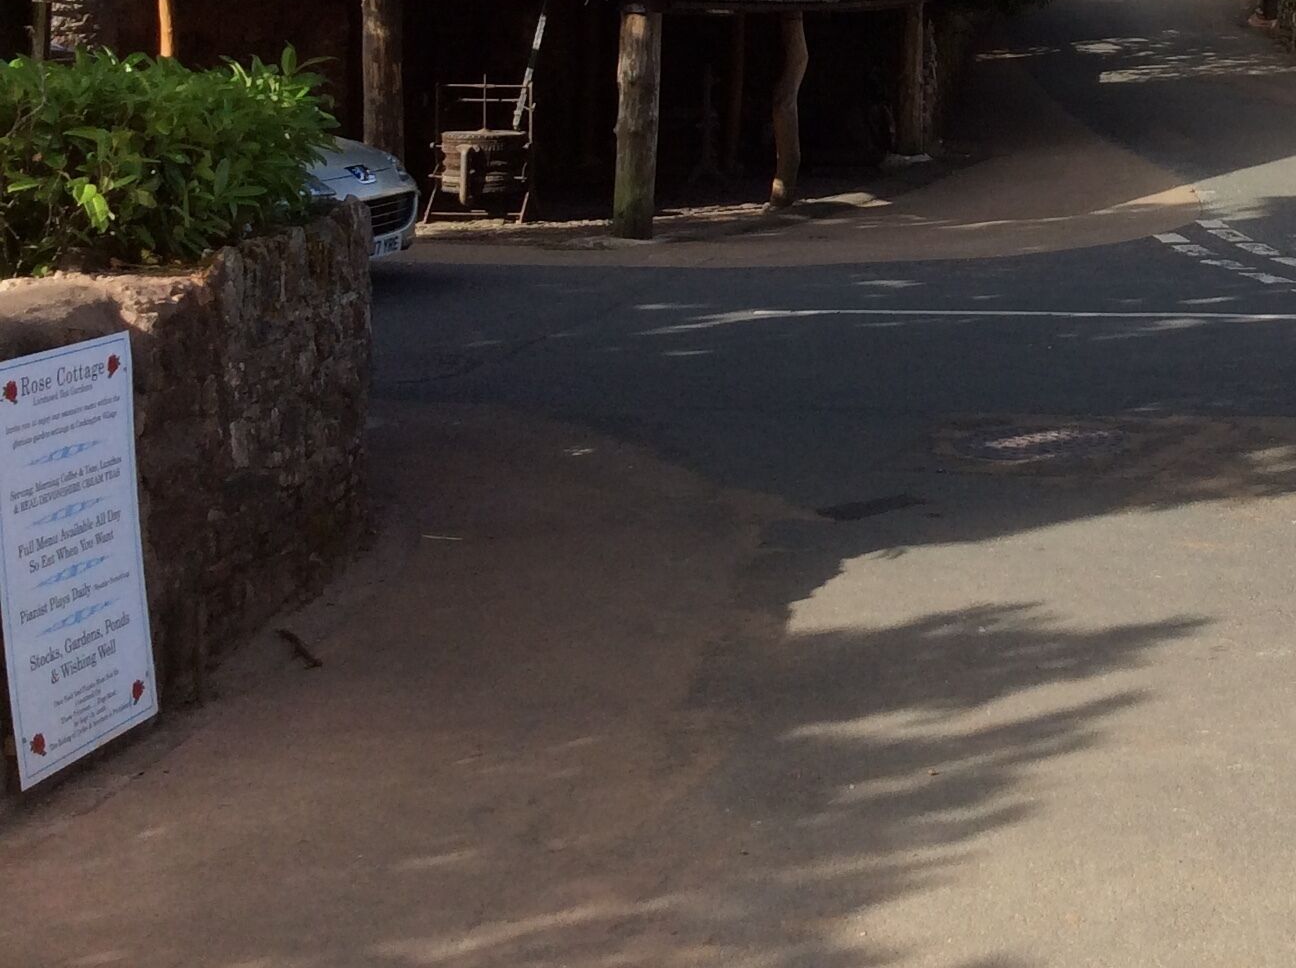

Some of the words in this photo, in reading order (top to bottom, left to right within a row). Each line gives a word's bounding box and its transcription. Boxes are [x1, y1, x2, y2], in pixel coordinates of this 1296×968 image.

[20, 376, 51, 400] Rose
[56, 362, 104, 392] Cottage
[35, 478, 59, 492] Morning
[81, 473, 104, 489] CREAM
[18, 540, 34, 558] Full
[35, 534, 58, 551] Menu
[60, 518, 93, 542] Available
[95, 512, 106, 527] All
[107, 509, 121, 522] Day
[29, 560, 39, 573] So
[41, 554, 55, 568] Eat
[55, 546, 78, 560] When
[79, 538, 93, 551] You
[94, 530, 114, 544] Want
[19, 603, 47, 625] Pianist
[49, 594, 70, 611] Plays
[71, 583, 91, 601] Daily
[29, 646, 63, 671] Stocks,
[64, 628, 103, 653] Gardens,
[104, 611, 130, 634] Ponds
[51, 668, 59, 684] &
[60, 652, 97, 678] Wishing
[97, 638, 116, 659] Well
